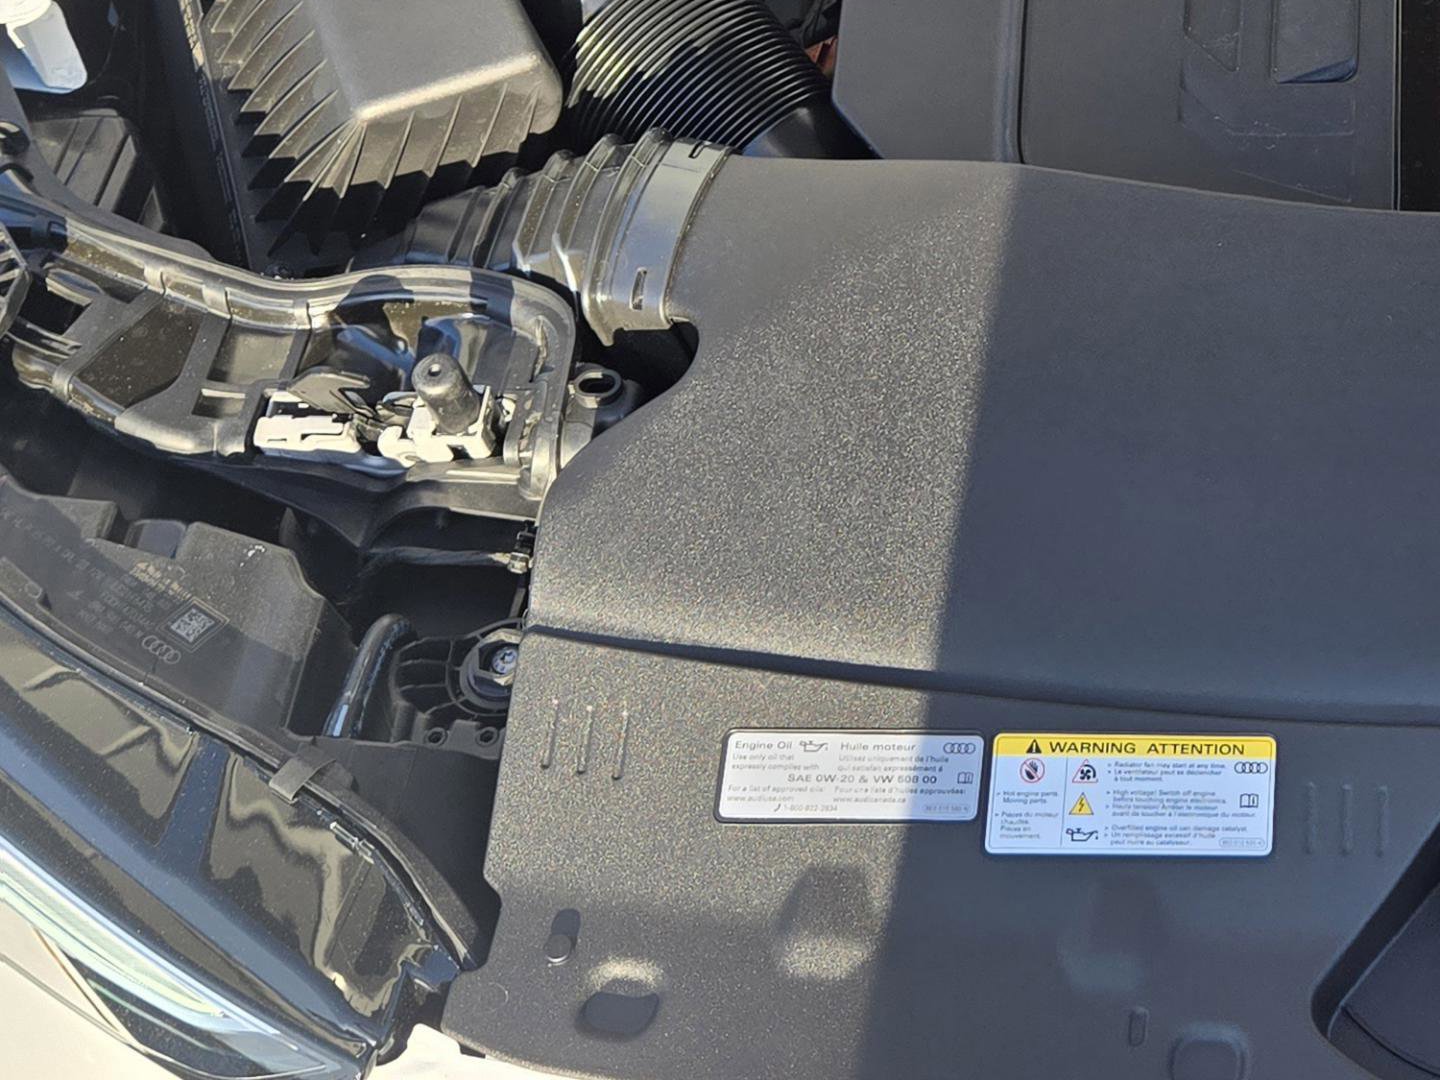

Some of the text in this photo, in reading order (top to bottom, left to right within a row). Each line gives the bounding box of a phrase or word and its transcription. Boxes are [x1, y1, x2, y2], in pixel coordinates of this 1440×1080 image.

[735, 740, 792, 751] Engine Oil
[840, 742, 916, 751] Huile moteur
[1049, 741, 1245, 756] WARNING ATTENTION
[787, 773, 812, 783] SAE
[815, 774, 855, 784] 0W-20
[858, 774, 868, 783] &
[873, 775, 894, 784] VW
[921, 775, 937, 784] 00
[728, 784, 740, 792] For
